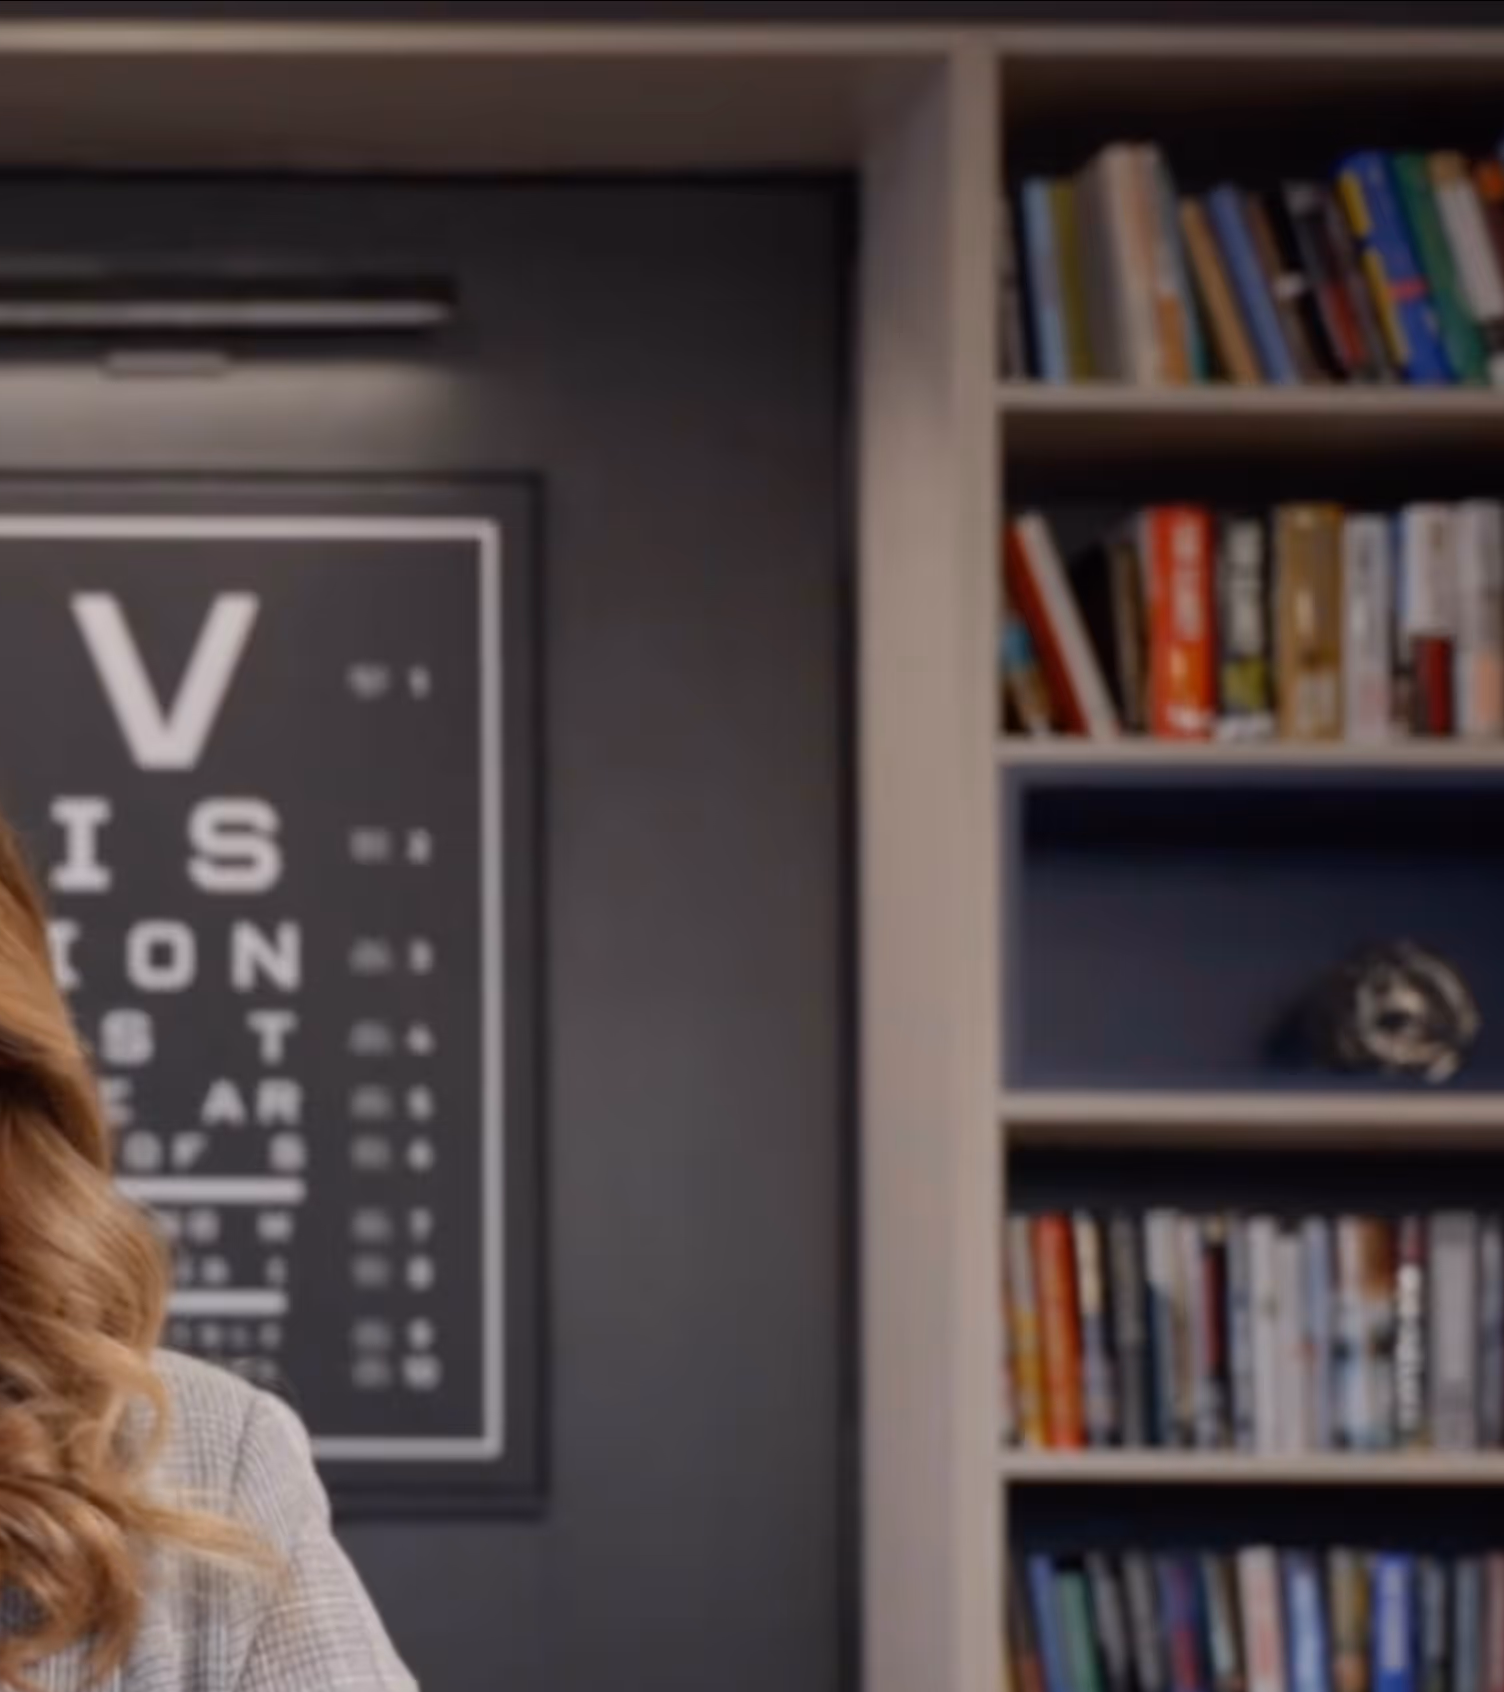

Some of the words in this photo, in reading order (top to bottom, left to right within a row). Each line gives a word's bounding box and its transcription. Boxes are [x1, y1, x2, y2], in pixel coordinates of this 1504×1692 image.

[69, 591, 260, 769] V
[47, 919, 302, 992] ION
[82, 1008, 154, 1067] S
[246, 1009, 298, 1066] T
[201, 1077, 302, 1127] AR
